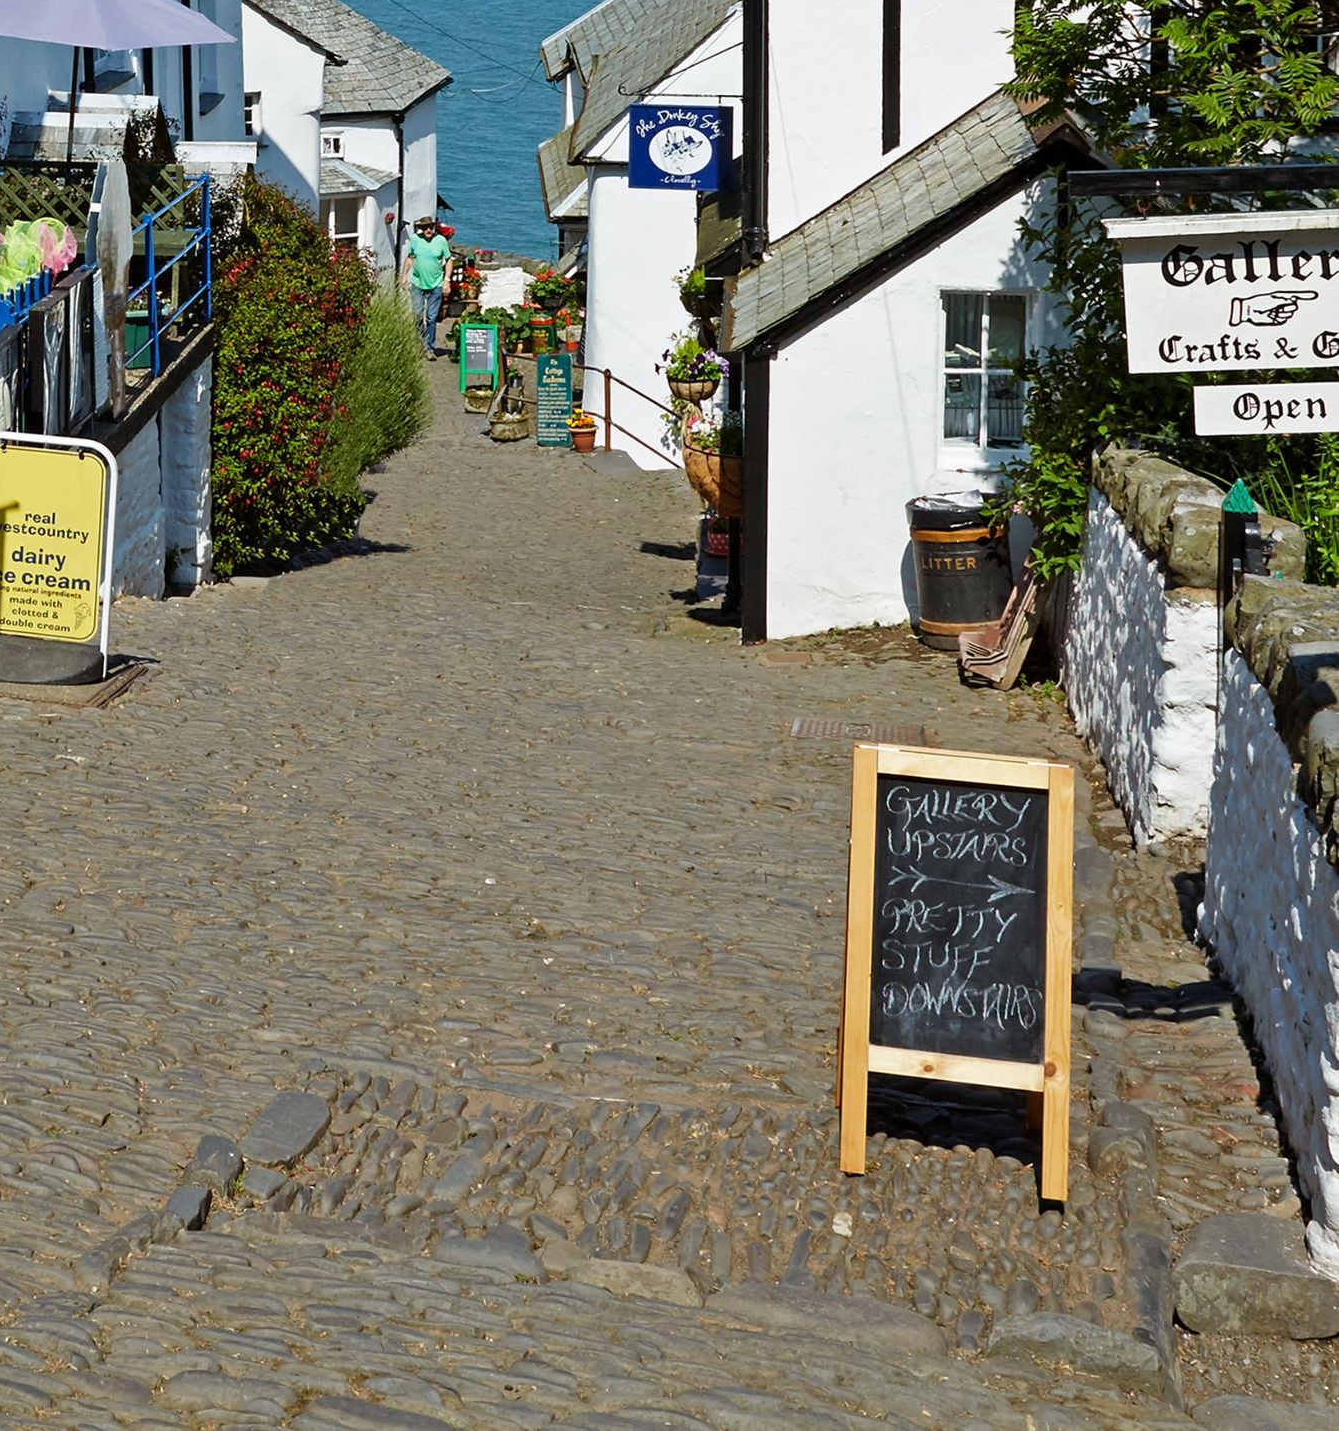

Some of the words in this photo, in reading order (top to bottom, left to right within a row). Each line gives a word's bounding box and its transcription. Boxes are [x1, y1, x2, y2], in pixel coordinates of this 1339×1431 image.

[636, 119, 656, 138] The
[657, 109, 699, 128] Donkey
[1159, 333, 1261, 363] Crafts
[1273, 337, 1299, 360] &
[1233, 392, 1327, 430] Open
[25, 512, 56, 525] real
[11, 546, 66, 571] dairy
[921, 555, 977, 570] LITTER
[12, 584, 39, 595] natural
[40, 587, 81, 600] ingredients
[21, 572, 91, 591] cream
[9, 596, 38, 606] made
[41, 597, 63, 609] with
[12, 607, 51, 619] clotted
[52, 611, 59, 620] &
[37, 622, 71, 633] cream
[886, 785, 1031, 832] GALLERY
[887, 827, 1027, 866] UPSTAIRS
[882, 897, 1017, 943] PRETTY
[882, 939, 994, 981] STUFF
[882, 981, 1043, 1034] DOWNSTAIRS
